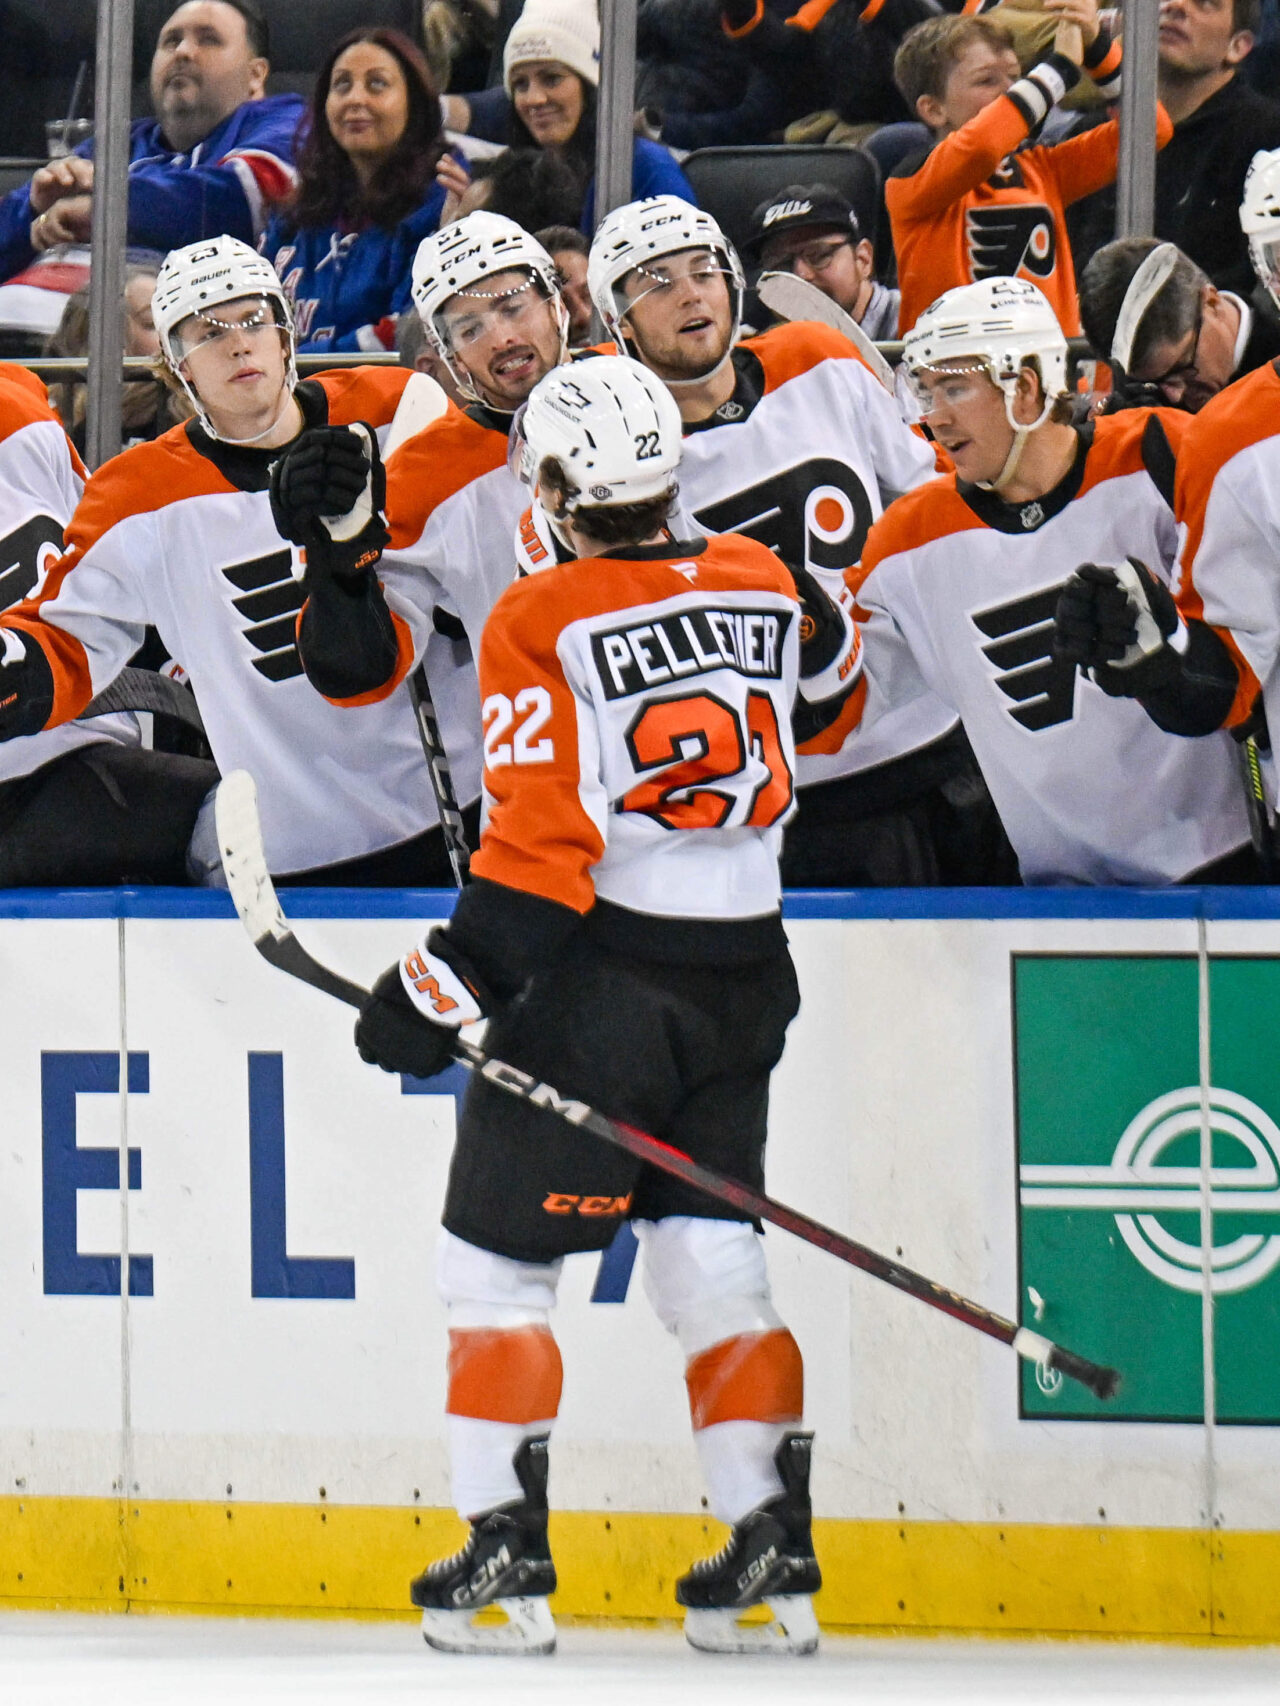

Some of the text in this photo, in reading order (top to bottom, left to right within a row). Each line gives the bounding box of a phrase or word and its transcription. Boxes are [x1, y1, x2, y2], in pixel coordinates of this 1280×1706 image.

[640, 214, 682, 232] CCM
[191, 268, 231, 286] BAUER
[440, 244, 481, 272] CCM
[634, 431, 663, 461] 22
[602, 611, 779, 694] PELLETIER
[482, 686, 554, 774] 22
[452, 1543, 513, 1606] CCM
[737, 1545, 778, 1591] CCM
